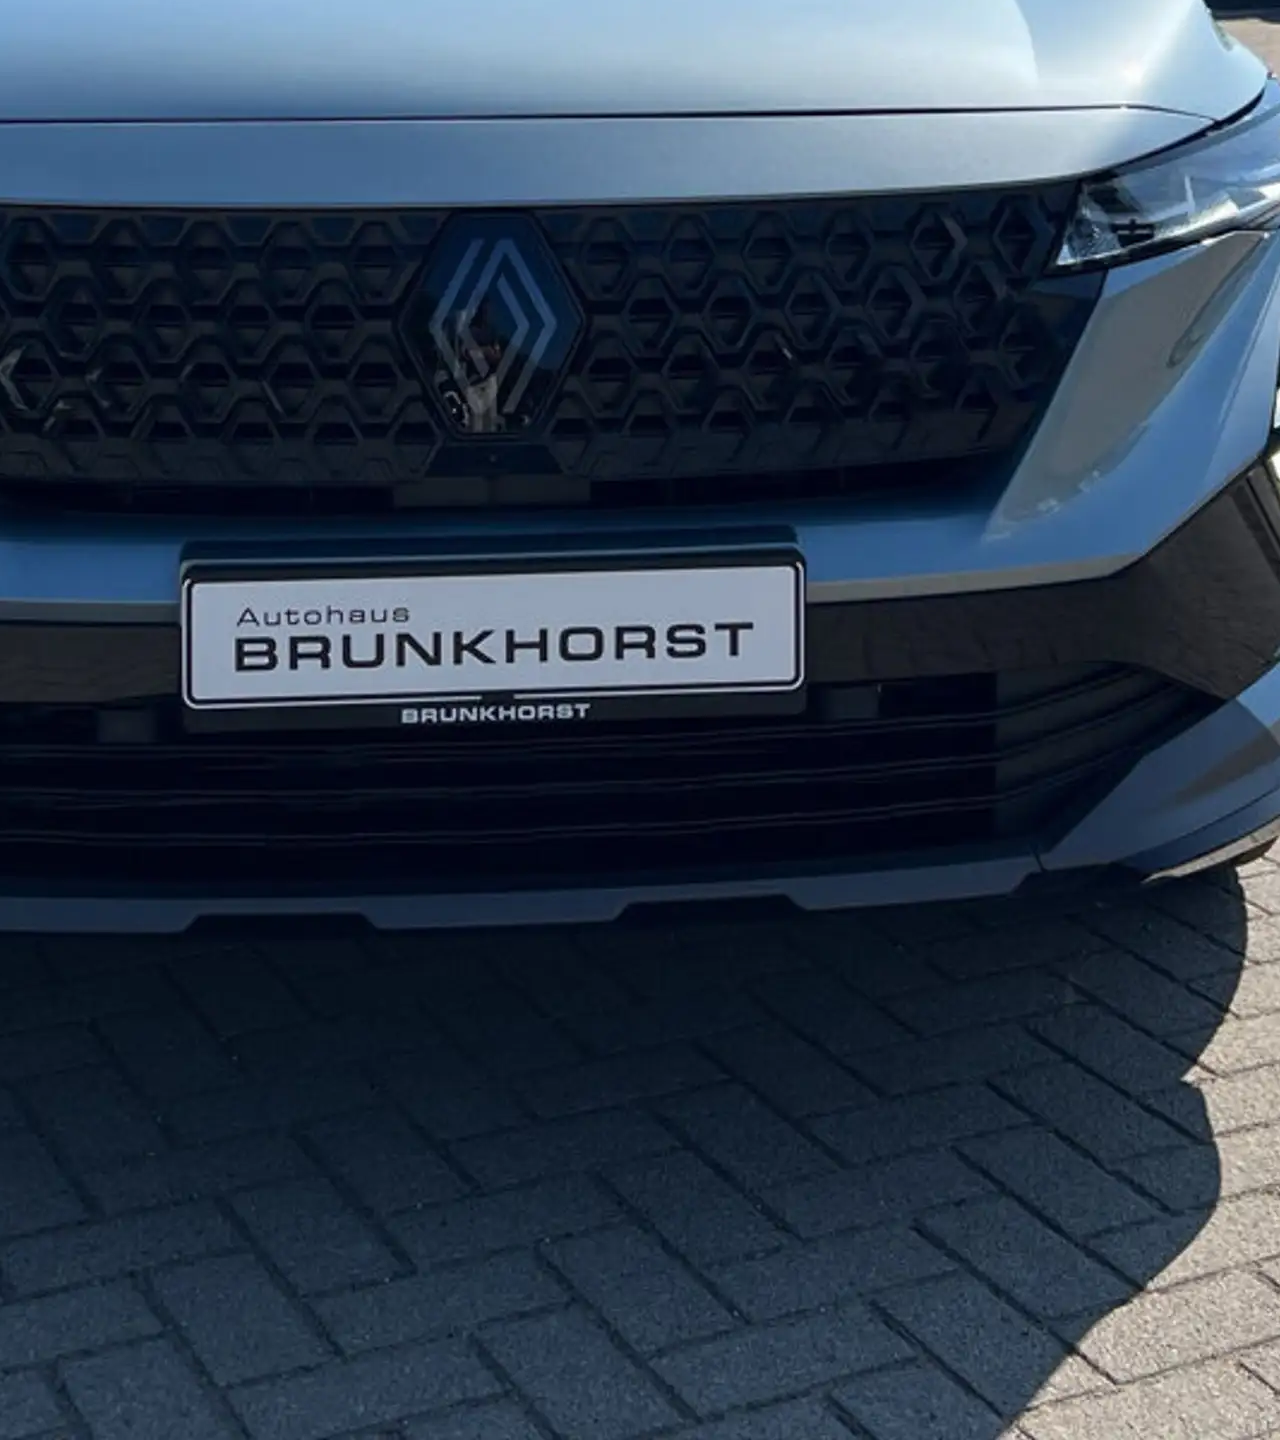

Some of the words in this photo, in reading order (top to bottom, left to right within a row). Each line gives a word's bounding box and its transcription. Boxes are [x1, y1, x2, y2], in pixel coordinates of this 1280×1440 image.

[235, 605, 411, 629] Autohaus
[234, 621, 755, 674] BRUNKHORST
[400, 703, 593, 725] BRUNKHORST
